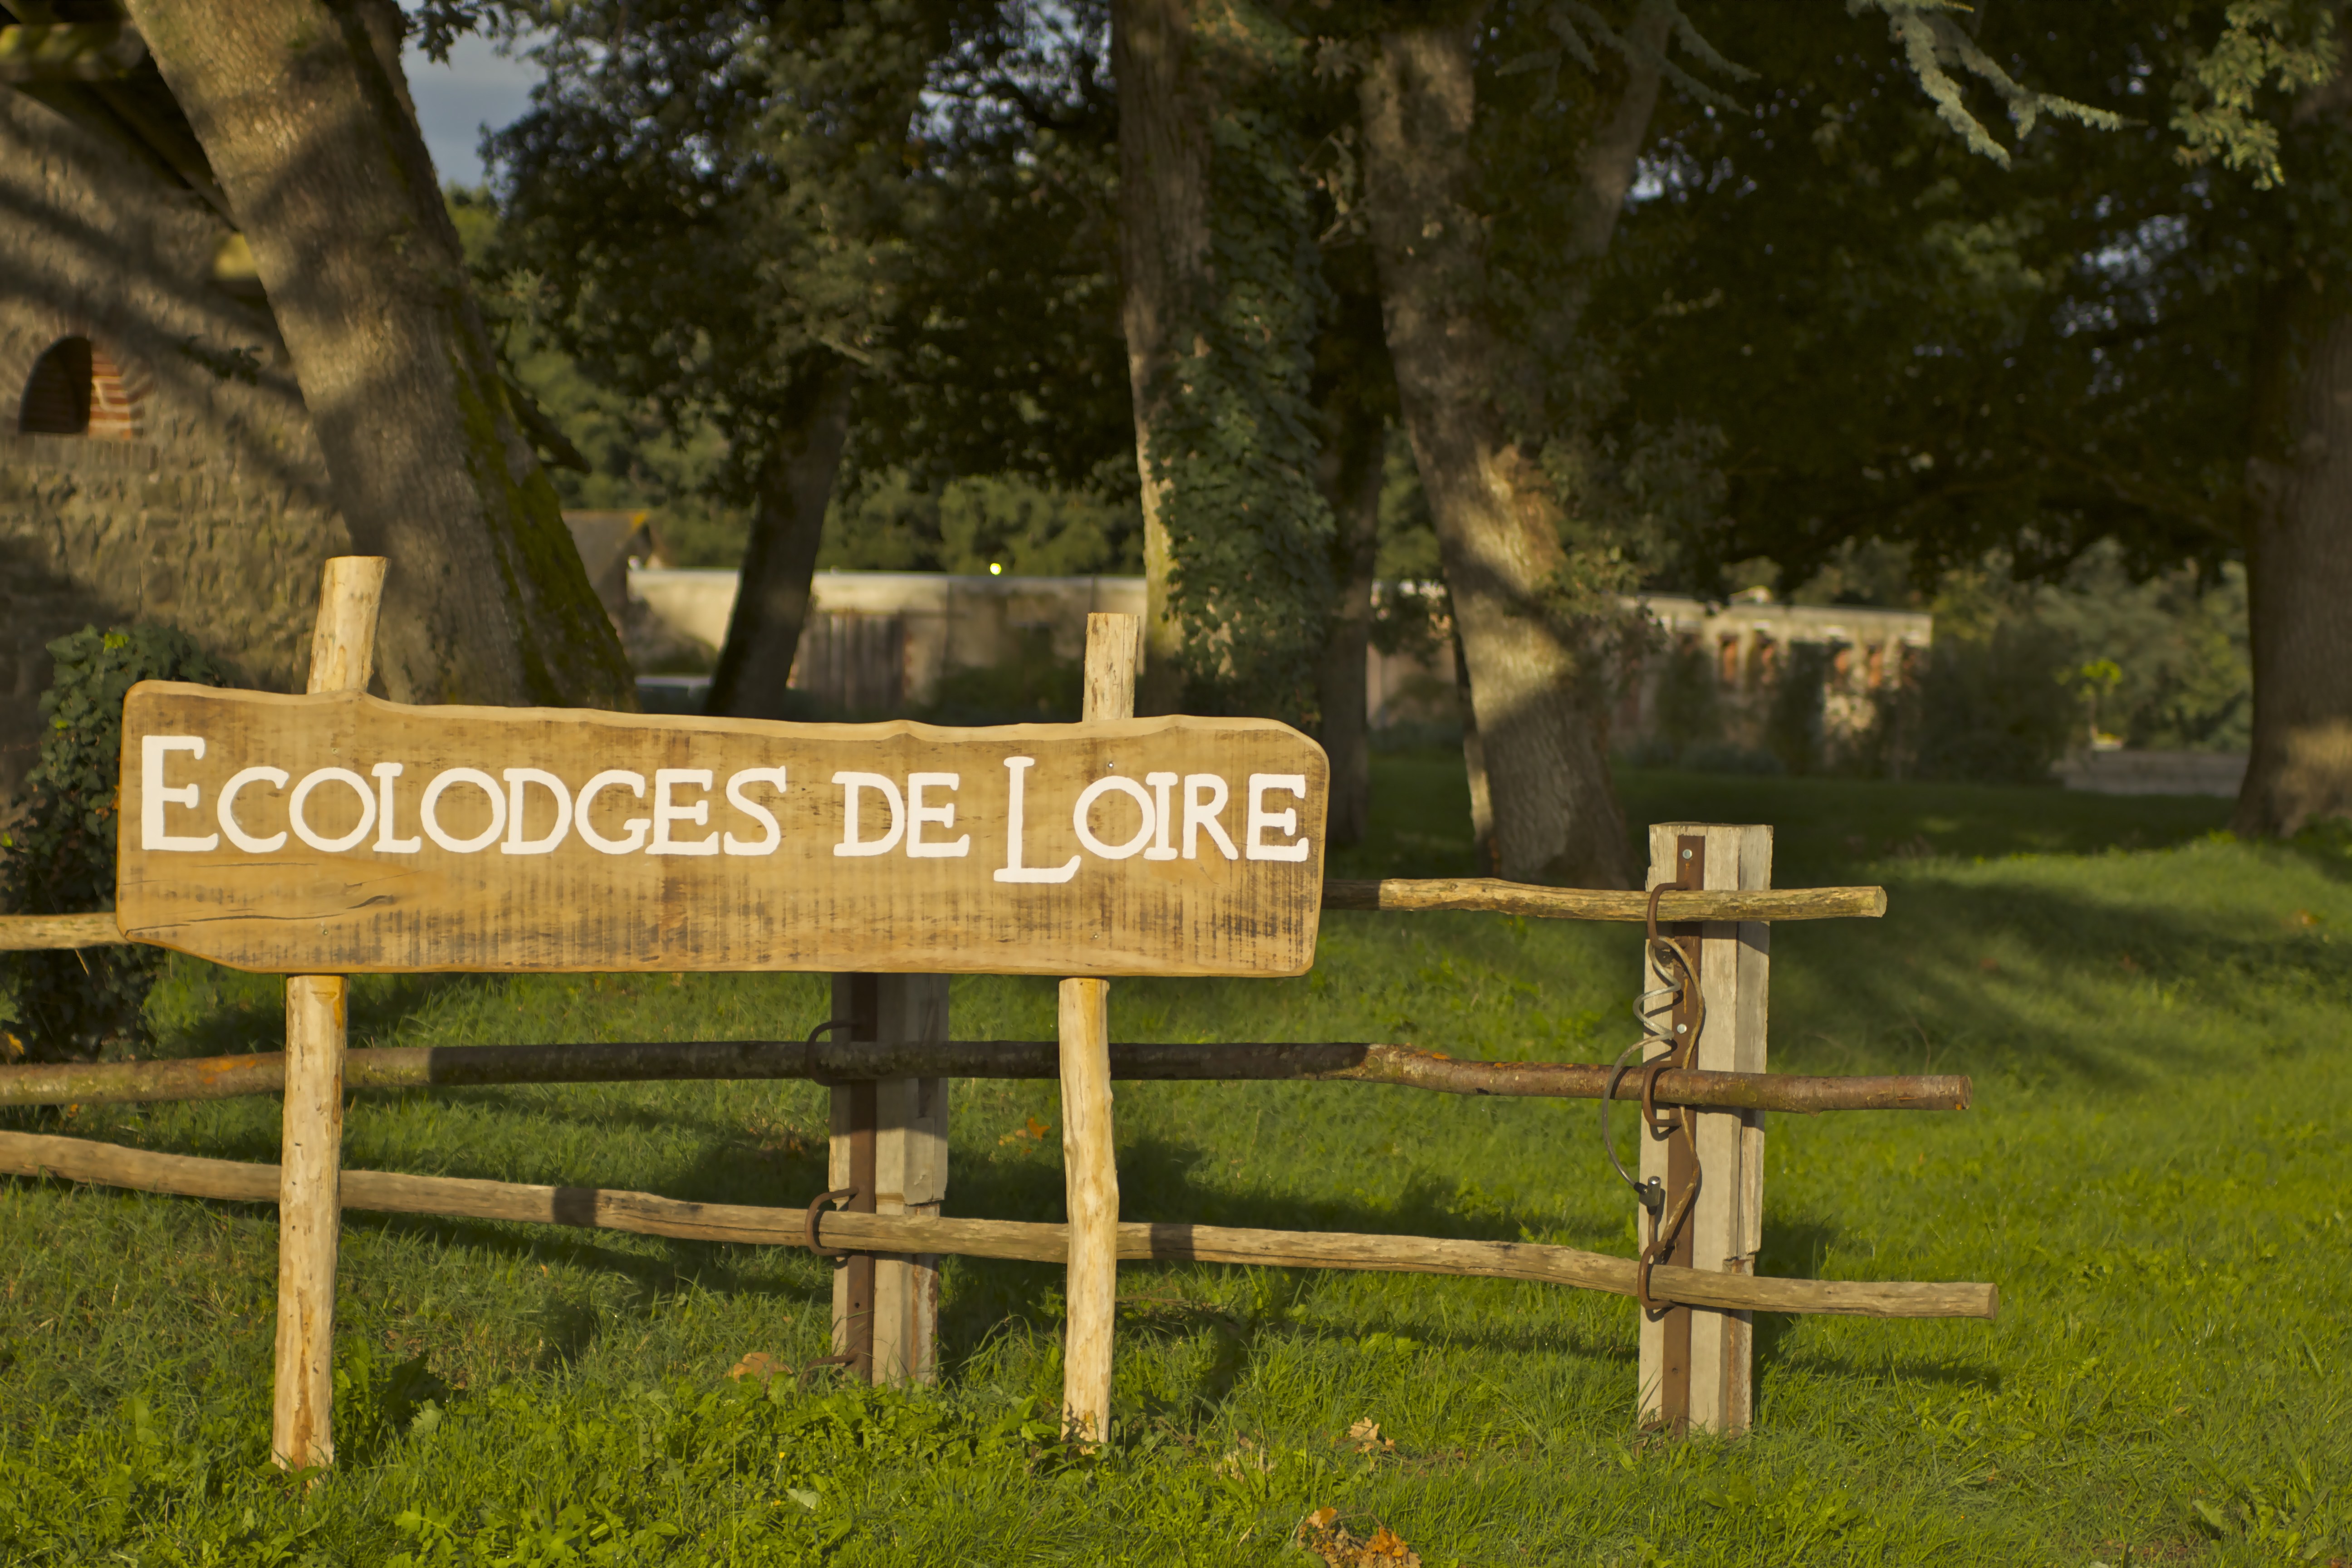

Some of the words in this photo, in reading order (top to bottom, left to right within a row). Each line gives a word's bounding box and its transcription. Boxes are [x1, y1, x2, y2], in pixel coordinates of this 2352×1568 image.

[141, 735, 787, 856] ECOLODGES
[831, 771, 970, 858] DE
[993, 756, 1309, 884] LOIRE
